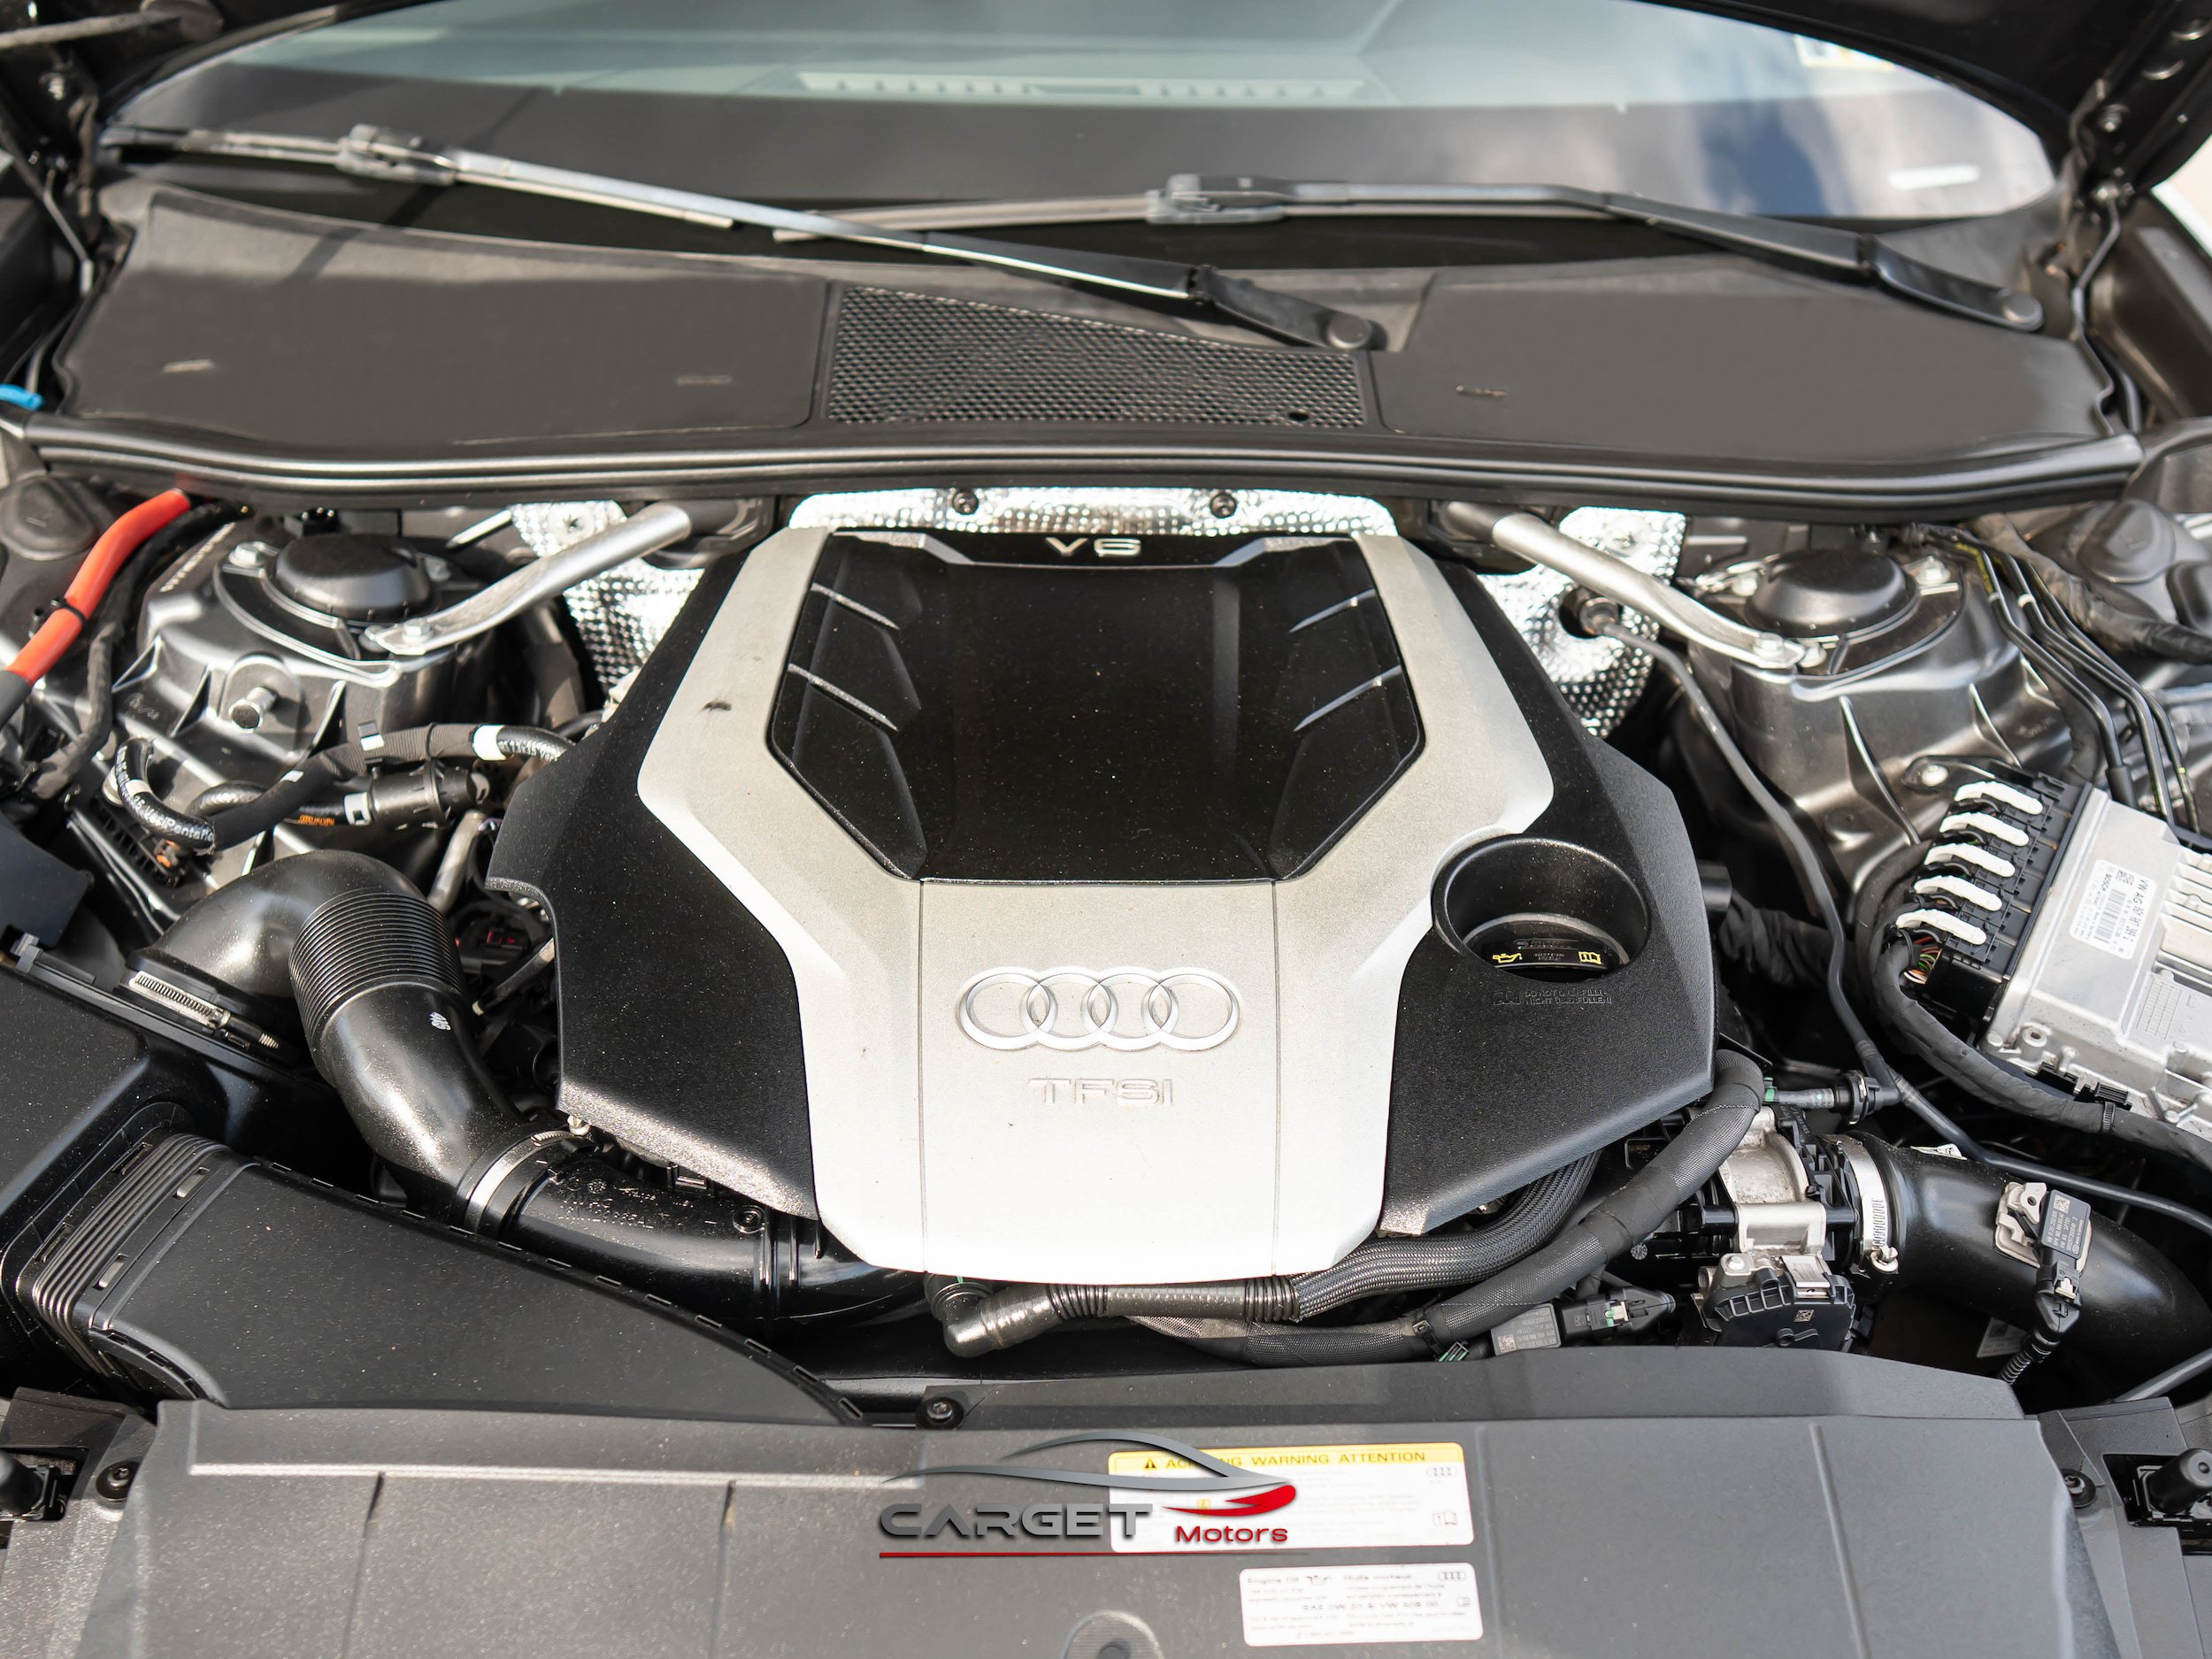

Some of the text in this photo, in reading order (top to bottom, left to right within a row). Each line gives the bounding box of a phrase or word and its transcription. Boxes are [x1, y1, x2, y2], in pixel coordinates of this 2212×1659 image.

[1045, 537, 1141, 557] V6
[1029, 1078, 1172, 1106] TFSI
[1252, 1454, 1329, 1467] WARNING
[1339, 1451, 1425, 1464] ATTENTION
